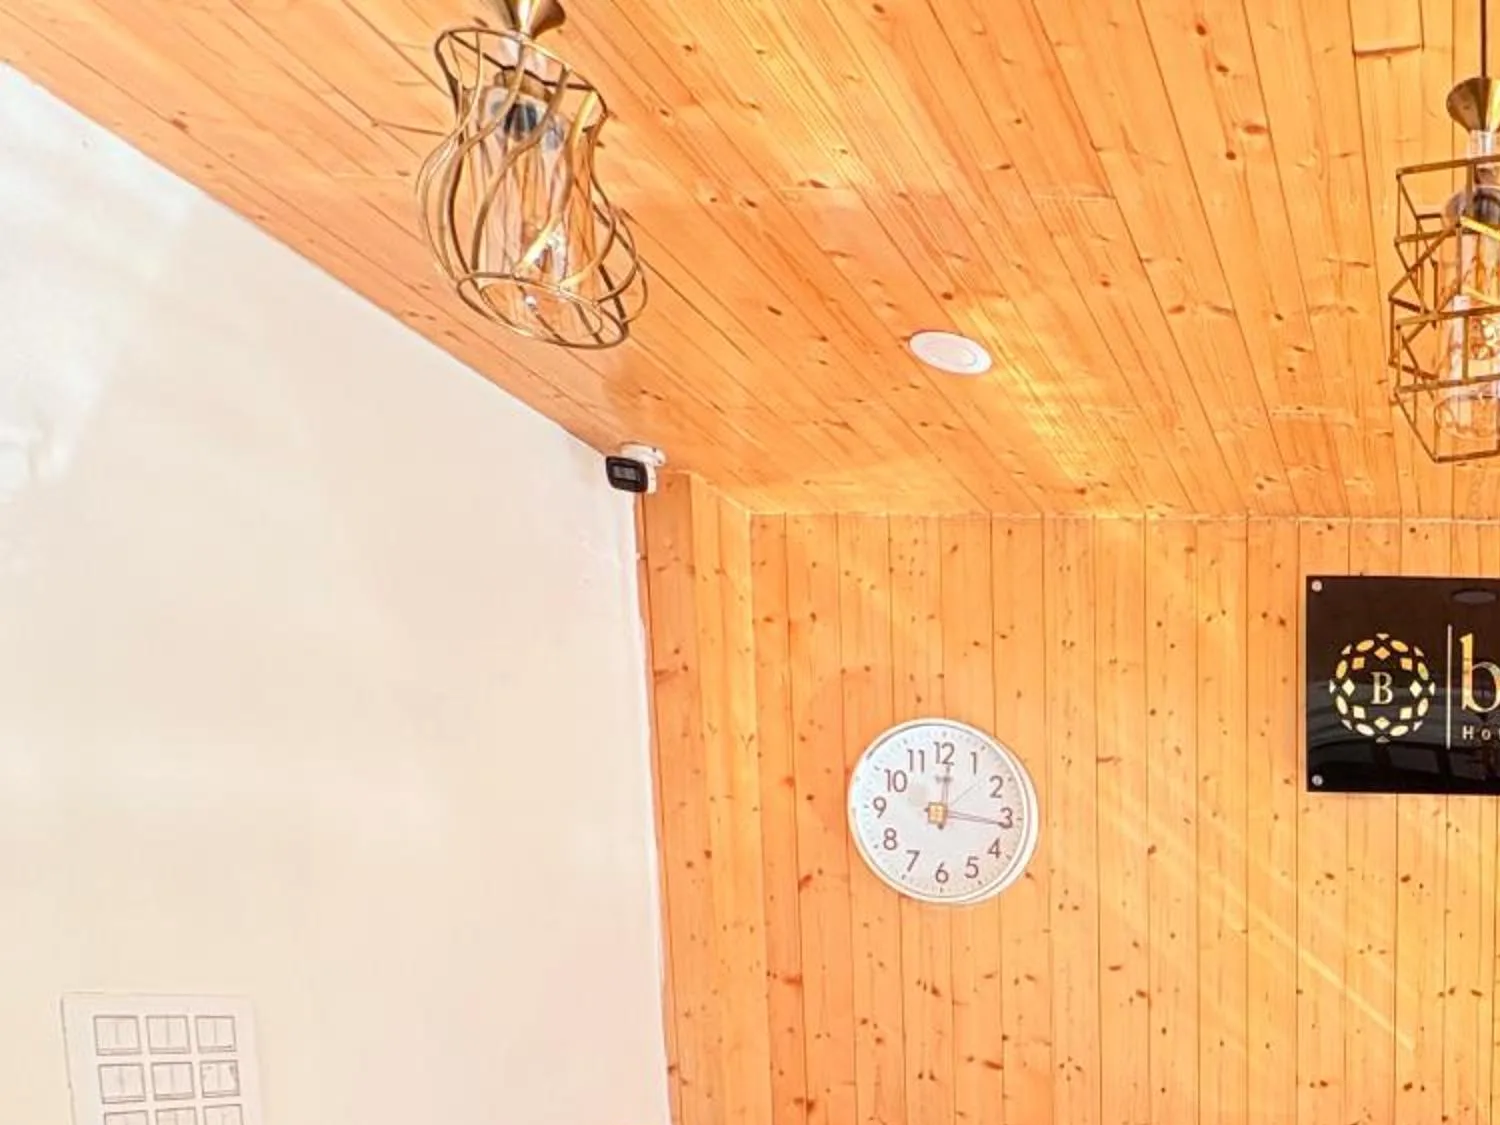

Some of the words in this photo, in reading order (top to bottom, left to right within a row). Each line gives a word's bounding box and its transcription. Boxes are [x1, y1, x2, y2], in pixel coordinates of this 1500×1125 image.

[1371, 671, 1393, 705] B
[907, 749, 925, 773] 11
[933, 741, 955, 766] 12
[970, 752, 978, 775] 1
[884, 769, 908, 793] 10
[989, 775, 1004, 798] 2
[873, 796, 887, 818] 9
[999, 807, 1013, 829] 3
[883, 828, 898, 850] 8
[988, 838, 1000, 859] 4
[907, 850, 920, 872] 7
[964, 856, 979, 879] 5
[935, 862, 949, 884] 6
